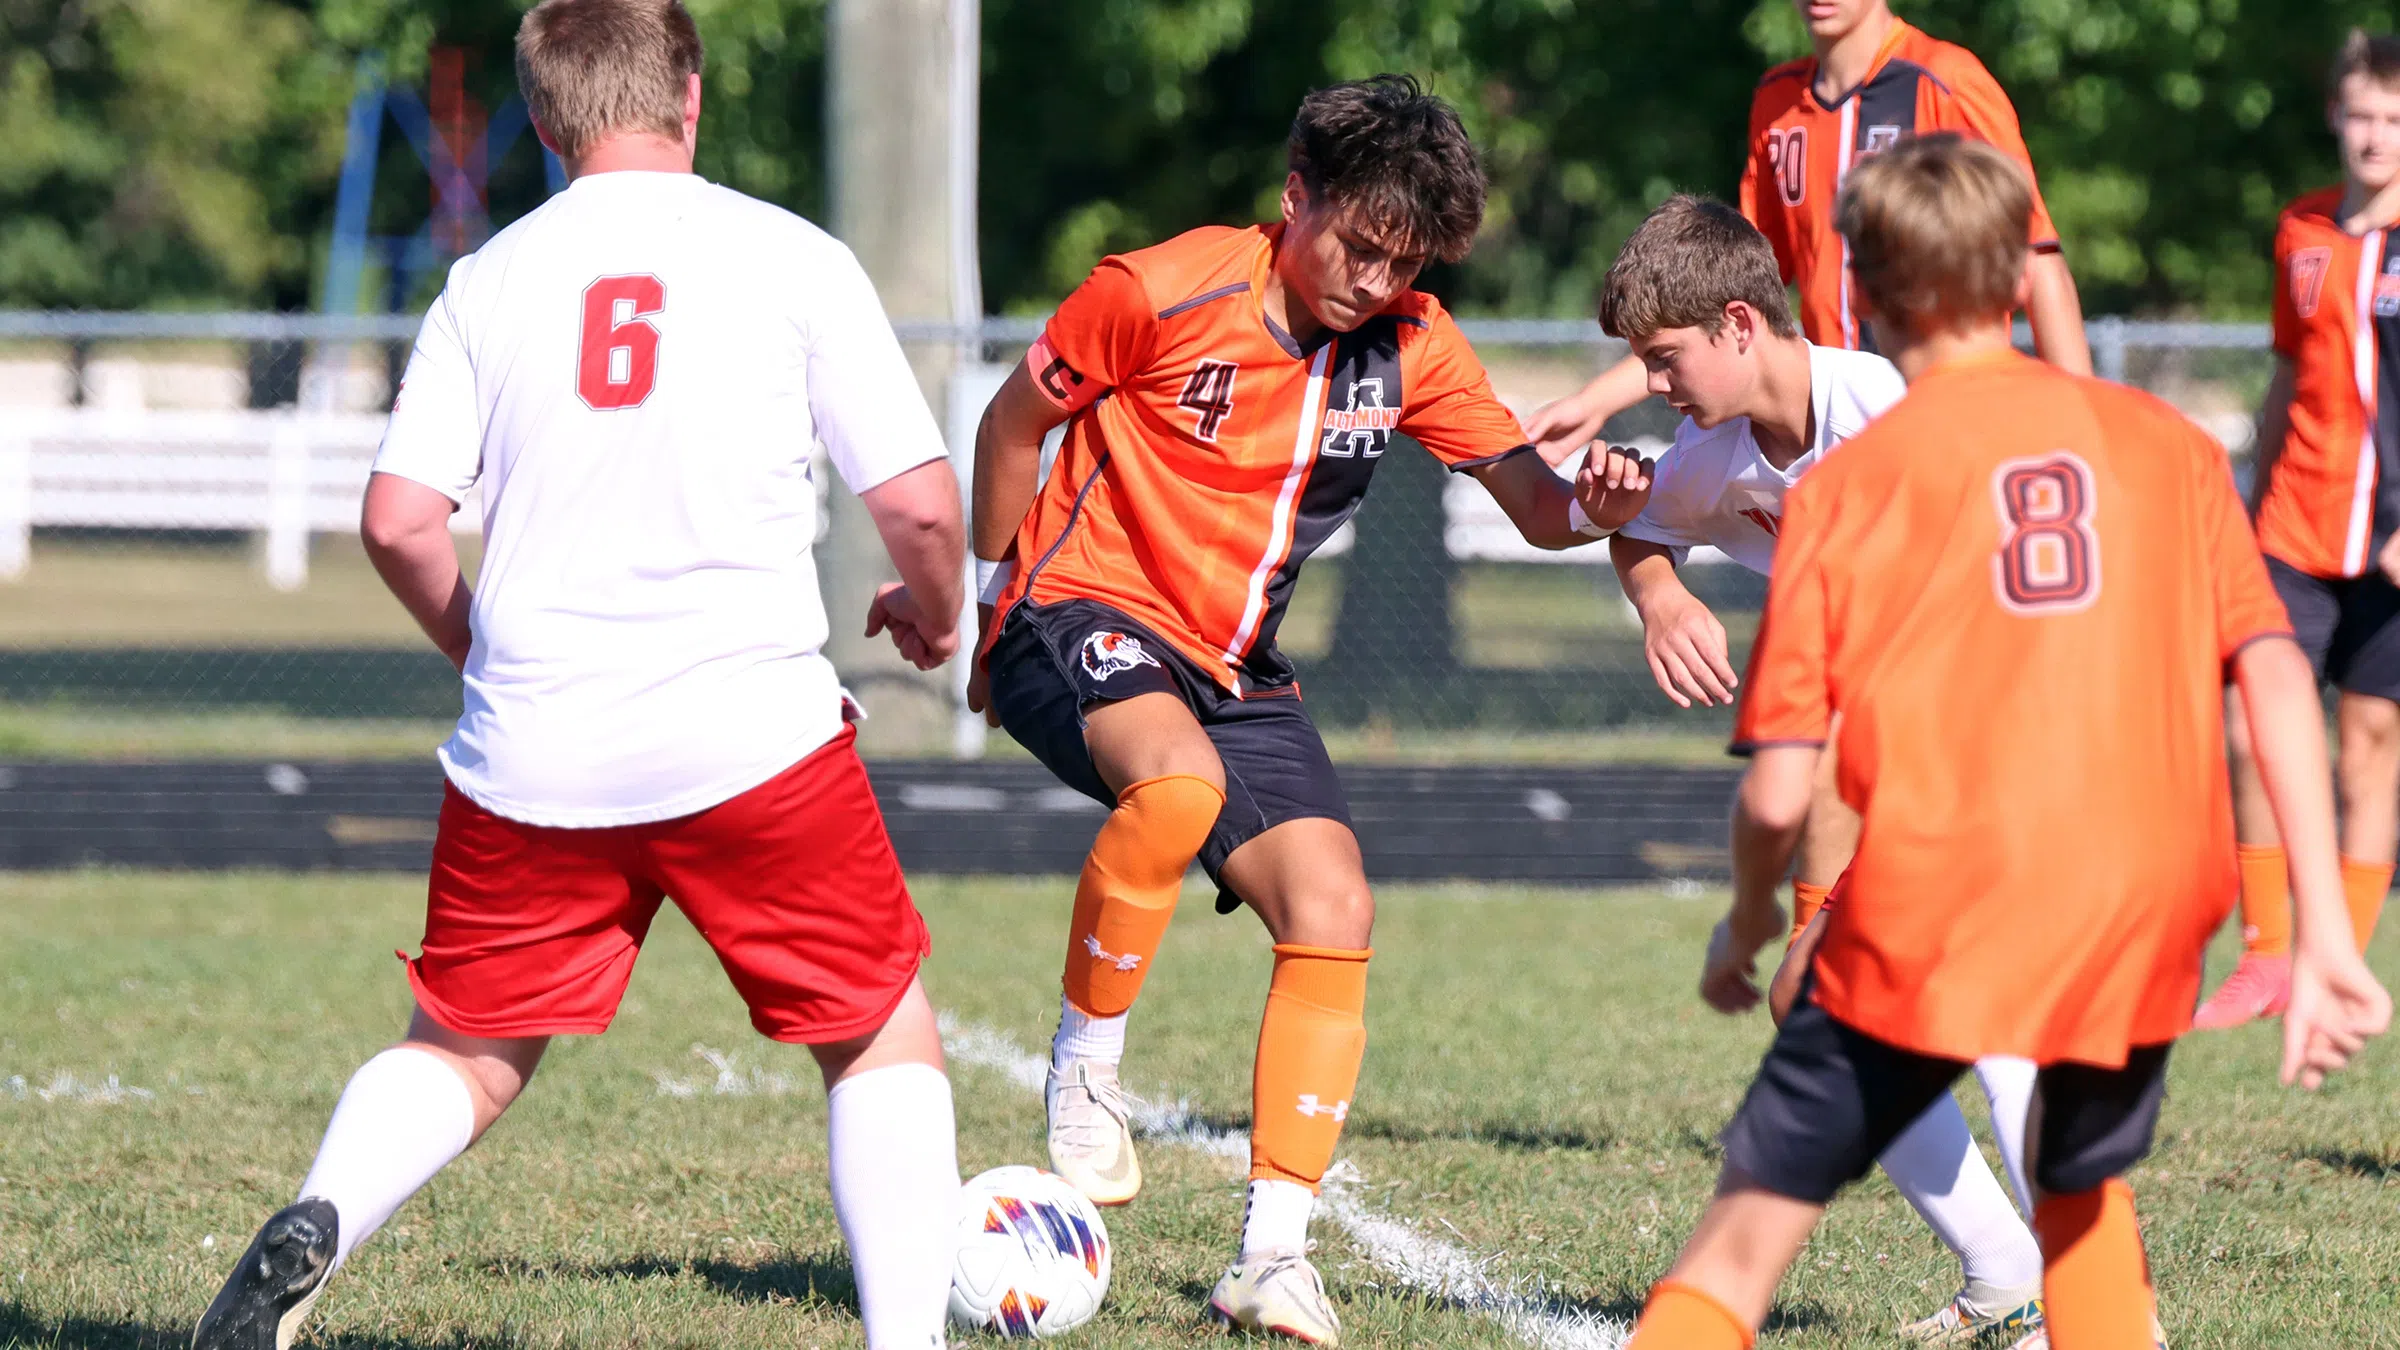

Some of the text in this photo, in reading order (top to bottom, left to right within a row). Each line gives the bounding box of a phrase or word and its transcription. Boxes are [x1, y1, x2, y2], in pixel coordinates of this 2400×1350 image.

[575, 272, 667, 412] 6
[1040, 355, 1085, 400] C
[1177, 358, 1240, 442] 4
[1992, 450, 2102, 617] 8
